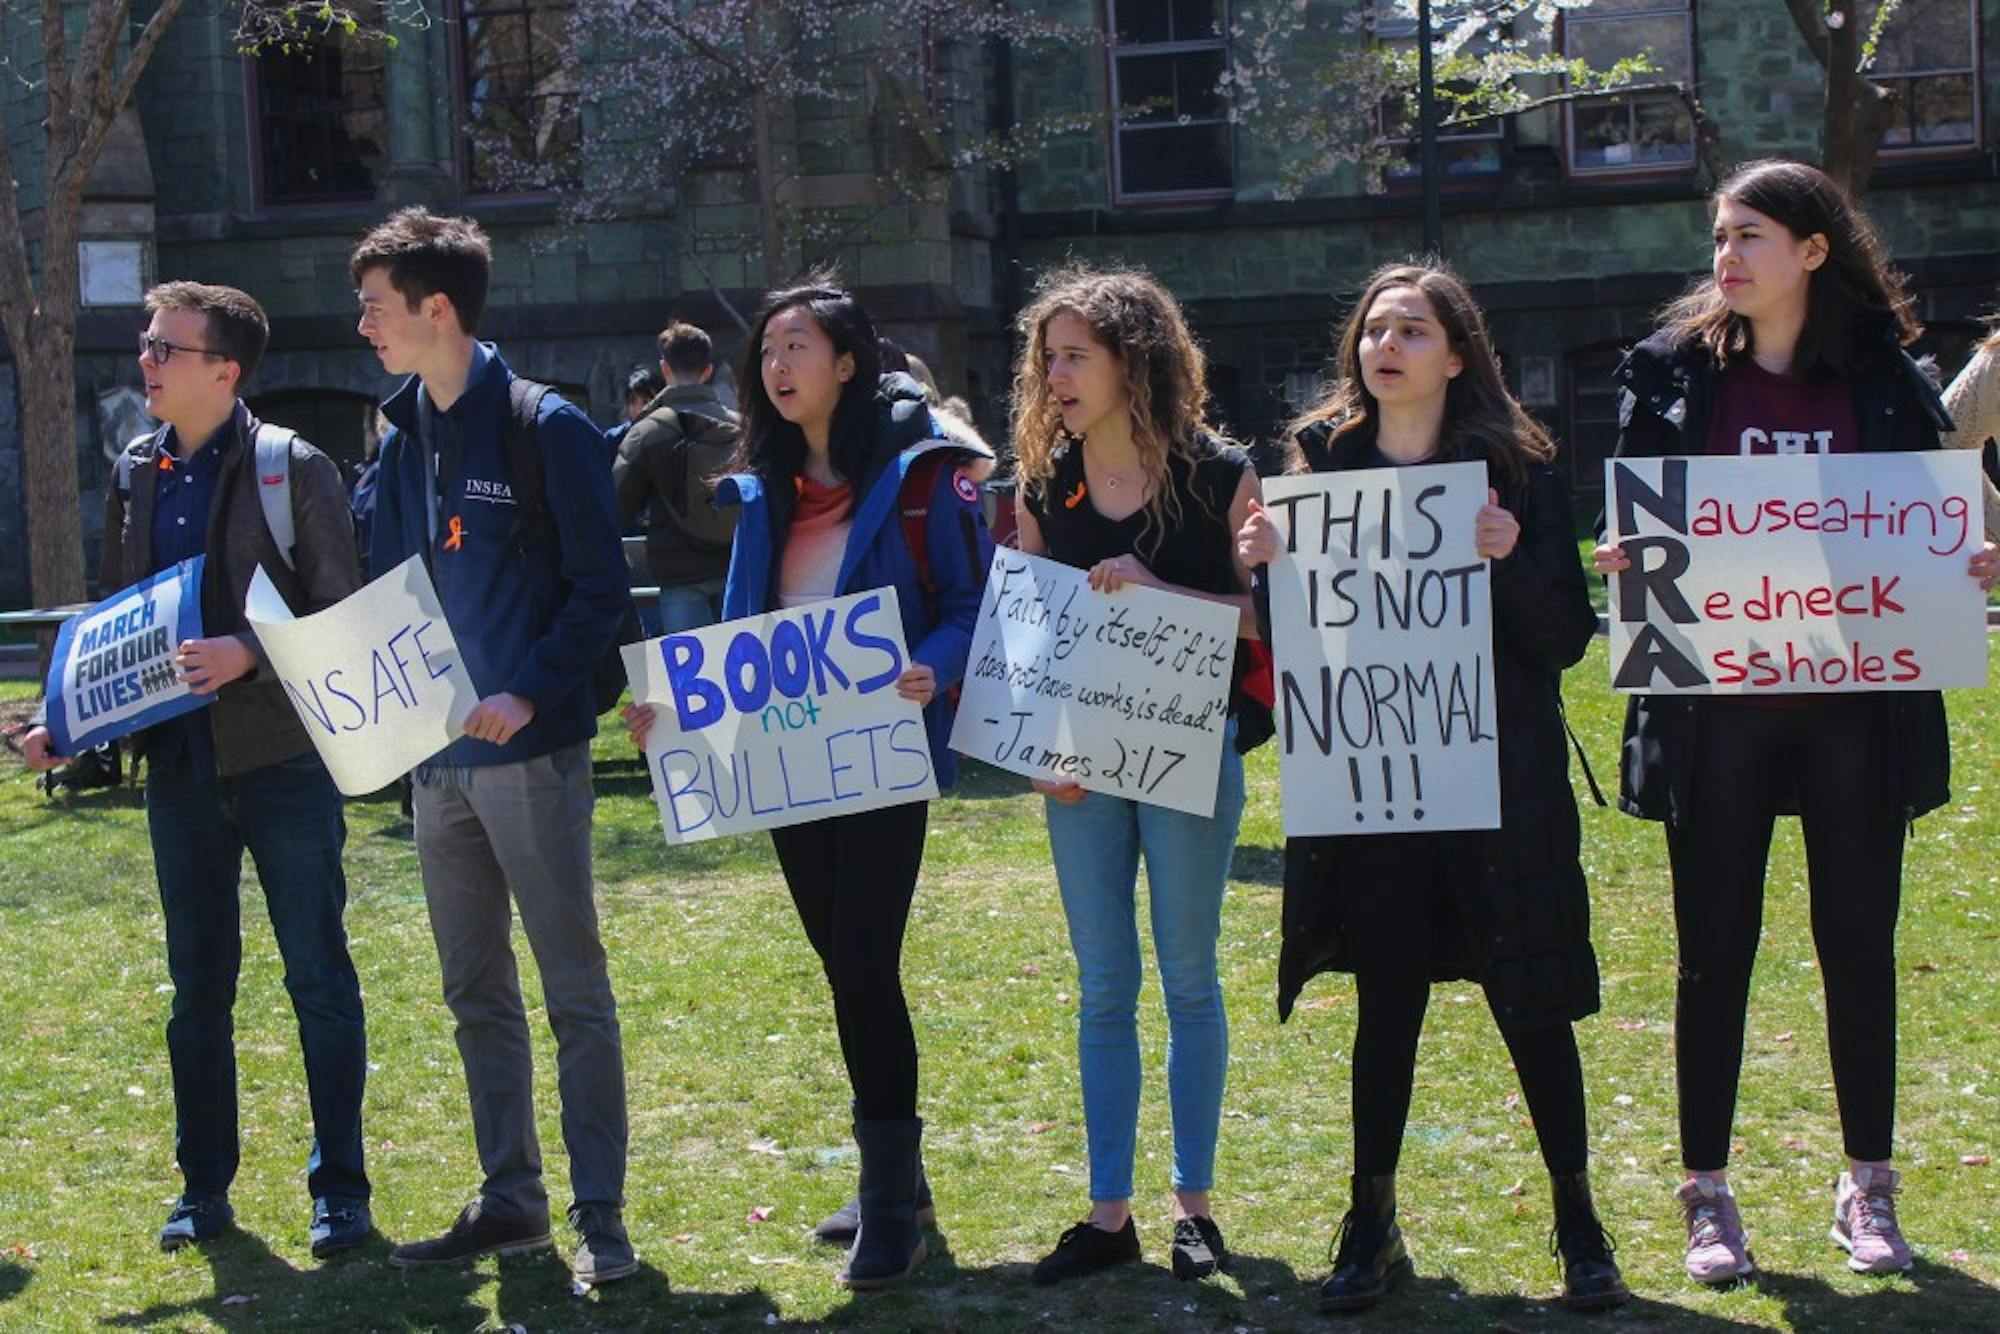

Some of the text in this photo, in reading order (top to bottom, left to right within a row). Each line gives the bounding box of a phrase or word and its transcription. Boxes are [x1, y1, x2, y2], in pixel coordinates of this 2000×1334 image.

[1267, 485, 1446, 559] THIS
[1614, 459, 1968, 556] Nauseating
[1309, 563, 1486, 629] IS NOT
[1617, 535, 1905, 624] Redneck
[75, 626, 169, 688] FOR OUR
[78, 599, 157, 657] MARCH
[1054, 584, 1088, 660] by
[1096, 607, 1176, 666] itself,
[1172, 628, 1202, 672] if
[1196, 637, 1226, 678] it
[1613, 622, 1920, 688] Assholes
[660, 595, 901, 732] BOOKS
[76, 673, 144, 722] LIVES
[761, 694, 820, 732] not
[1078, 682, 1134, 720] works,
[1137, 687, 1157, 720] is
[1281, 653, 1495, 755] NORMAL
[660, 720, 929, 833] BULLETS
[1102, 738, 1187, 794] 2:17
[1348, 754, 1424, 822] !!!
